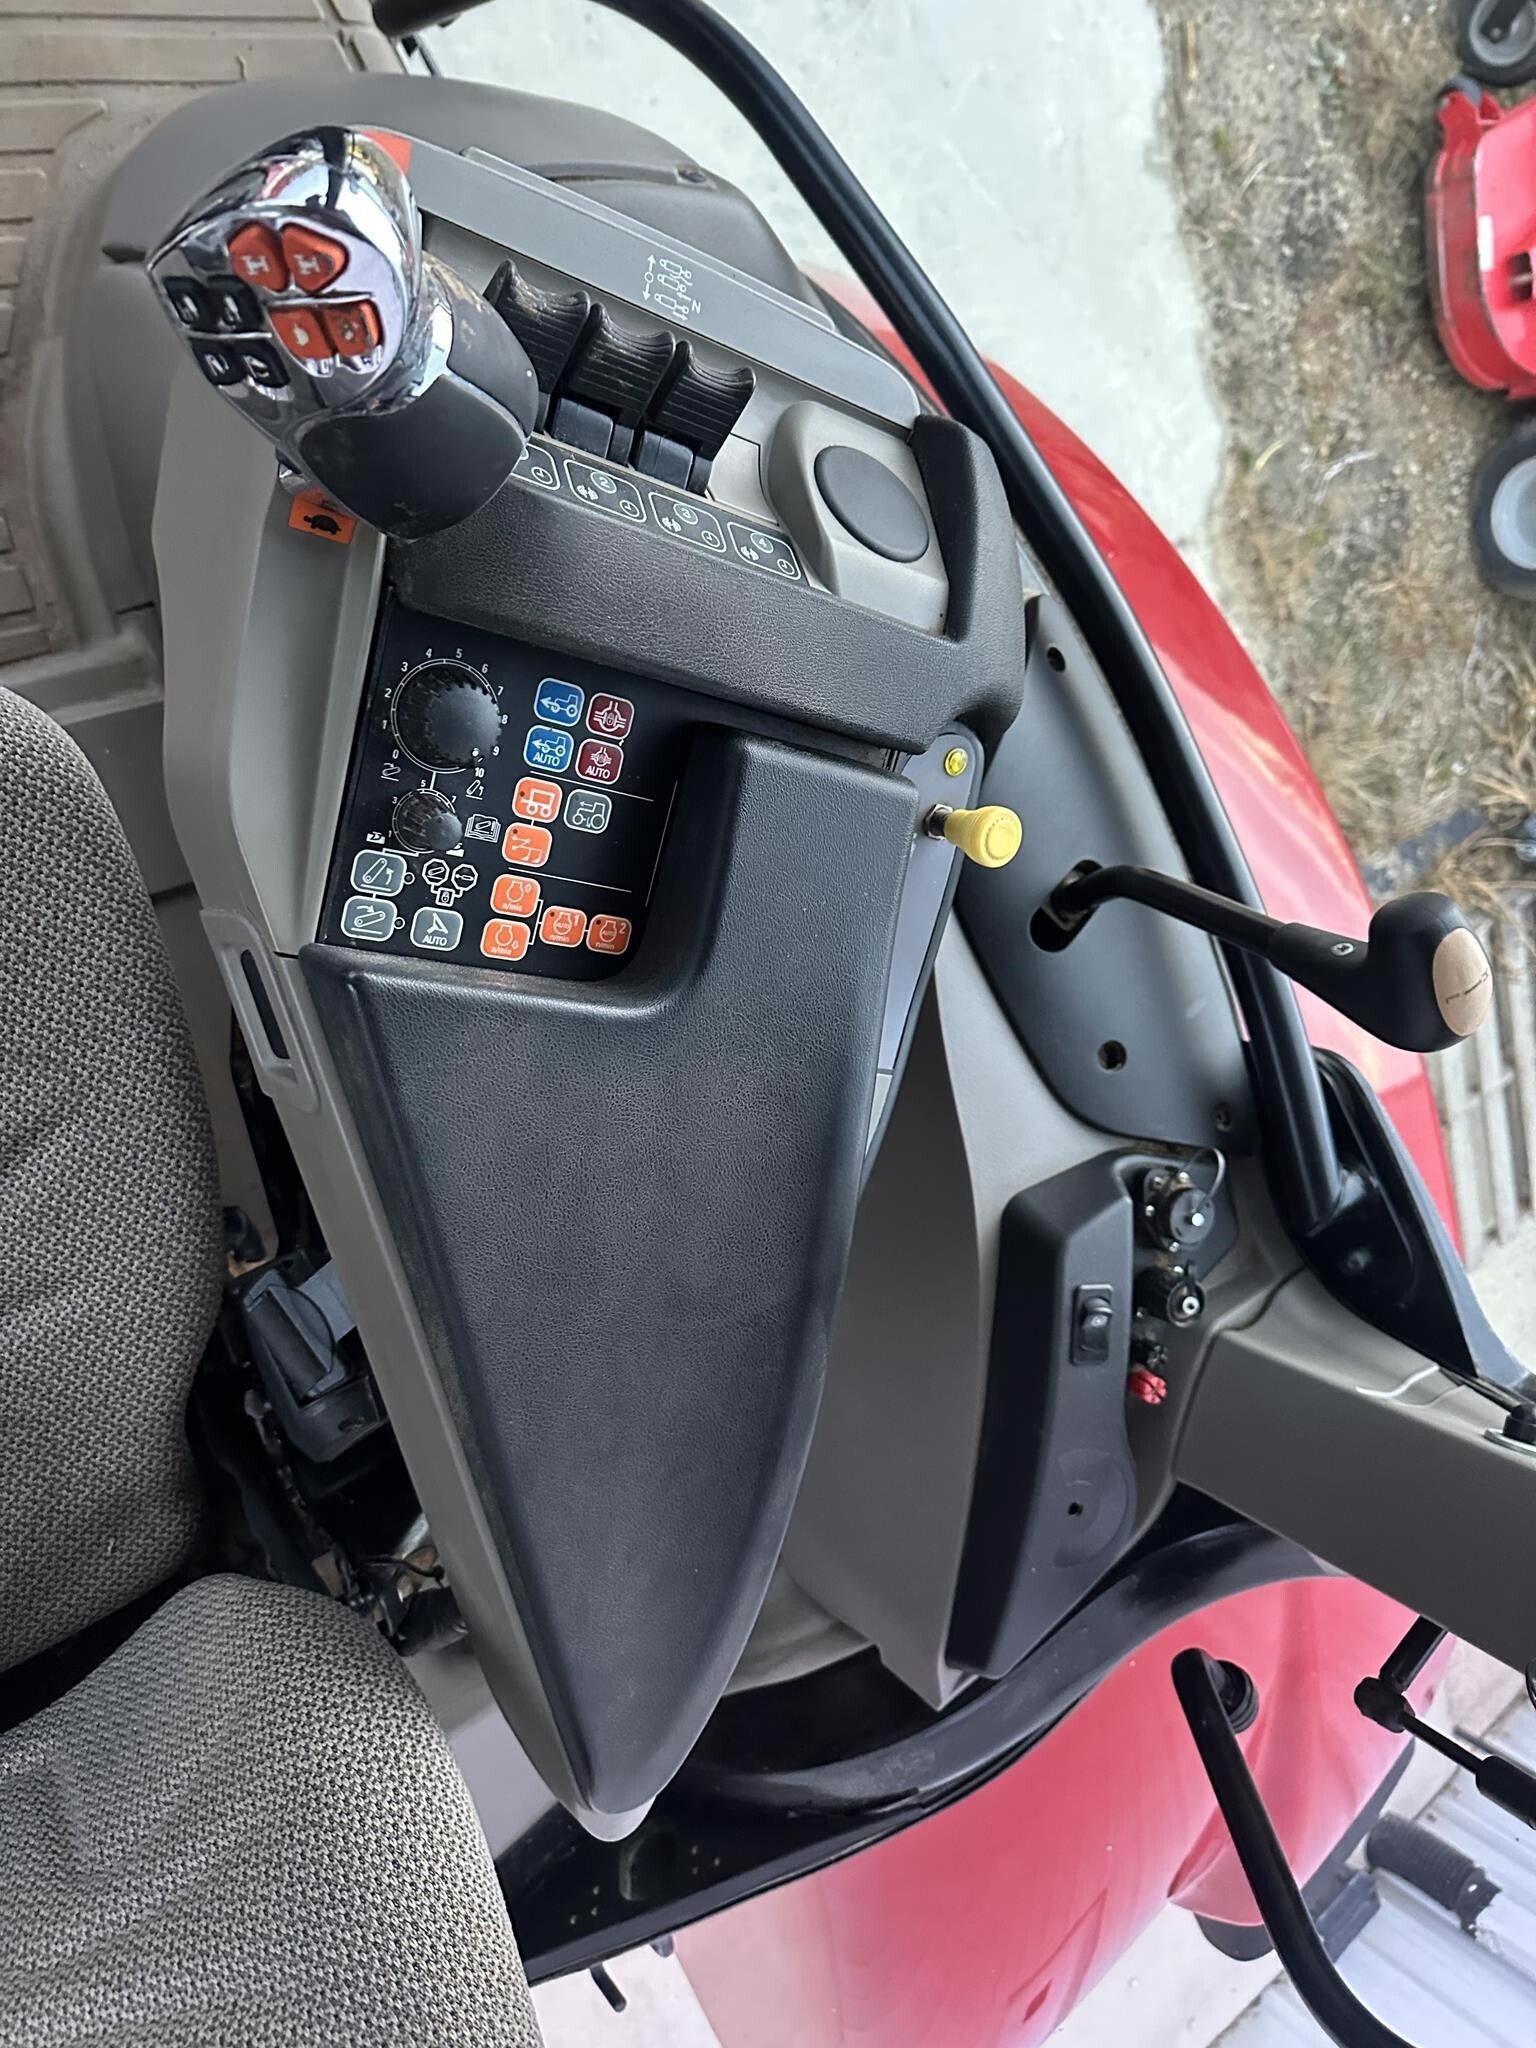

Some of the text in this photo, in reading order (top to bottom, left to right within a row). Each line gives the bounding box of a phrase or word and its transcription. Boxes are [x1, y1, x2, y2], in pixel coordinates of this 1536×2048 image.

[691, 298, 702, 314] N
[425, 648, 432, 659] 4
[455, 648, 463, 659] 5
[400, 661, 409, 672] 3
[481, 663, 489, 674] 6
[384, 687, 392, 699] 2
[497, 685, 504, 696] 7
[381, 720, 388, 730] 1
[501, 714, 509, 725] 8
[392, 749, 400, 759] 0
[492, 745, 500, 756] 9
[532, 752, 561, 767] AUTO
[474, 767, 485, 778] 10
[584, 765, 611, 779] AUTO
[420, 779, 426, 788] 5
[391, 796, 398, 804] 3
[451, 795, 457, 803] 7
[573, 914, 580, 927] 1
[619, 922, 627, 934] 2
[422, 934, 448, 947] AUTO
